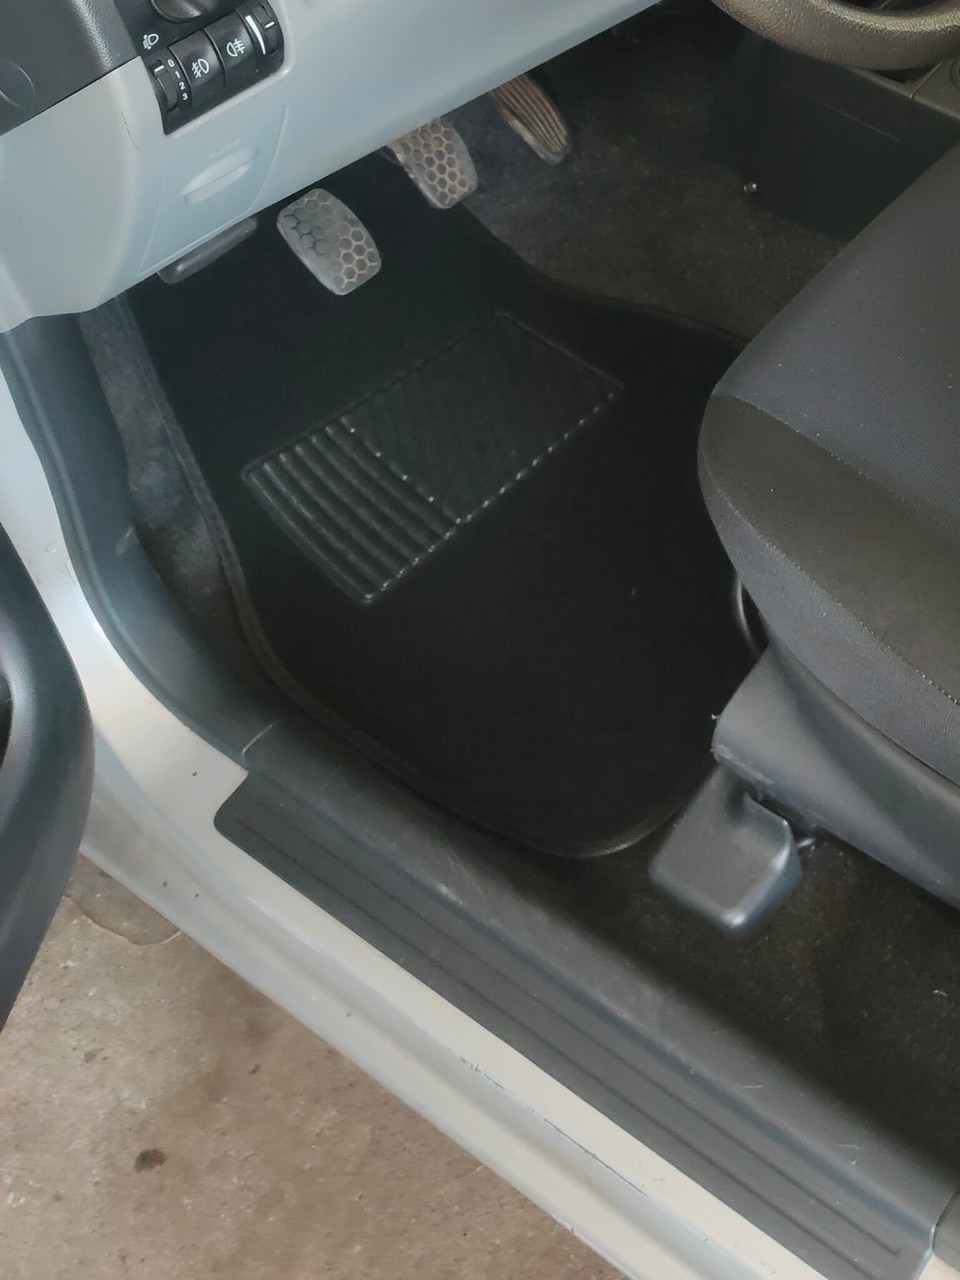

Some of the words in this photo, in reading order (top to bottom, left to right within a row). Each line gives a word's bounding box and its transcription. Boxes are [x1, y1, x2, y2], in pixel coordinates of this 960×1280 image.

[174, 70, 181, 79] 1
[178, 81, 186, 91] 2
[182, 92, 189, 101] 3
